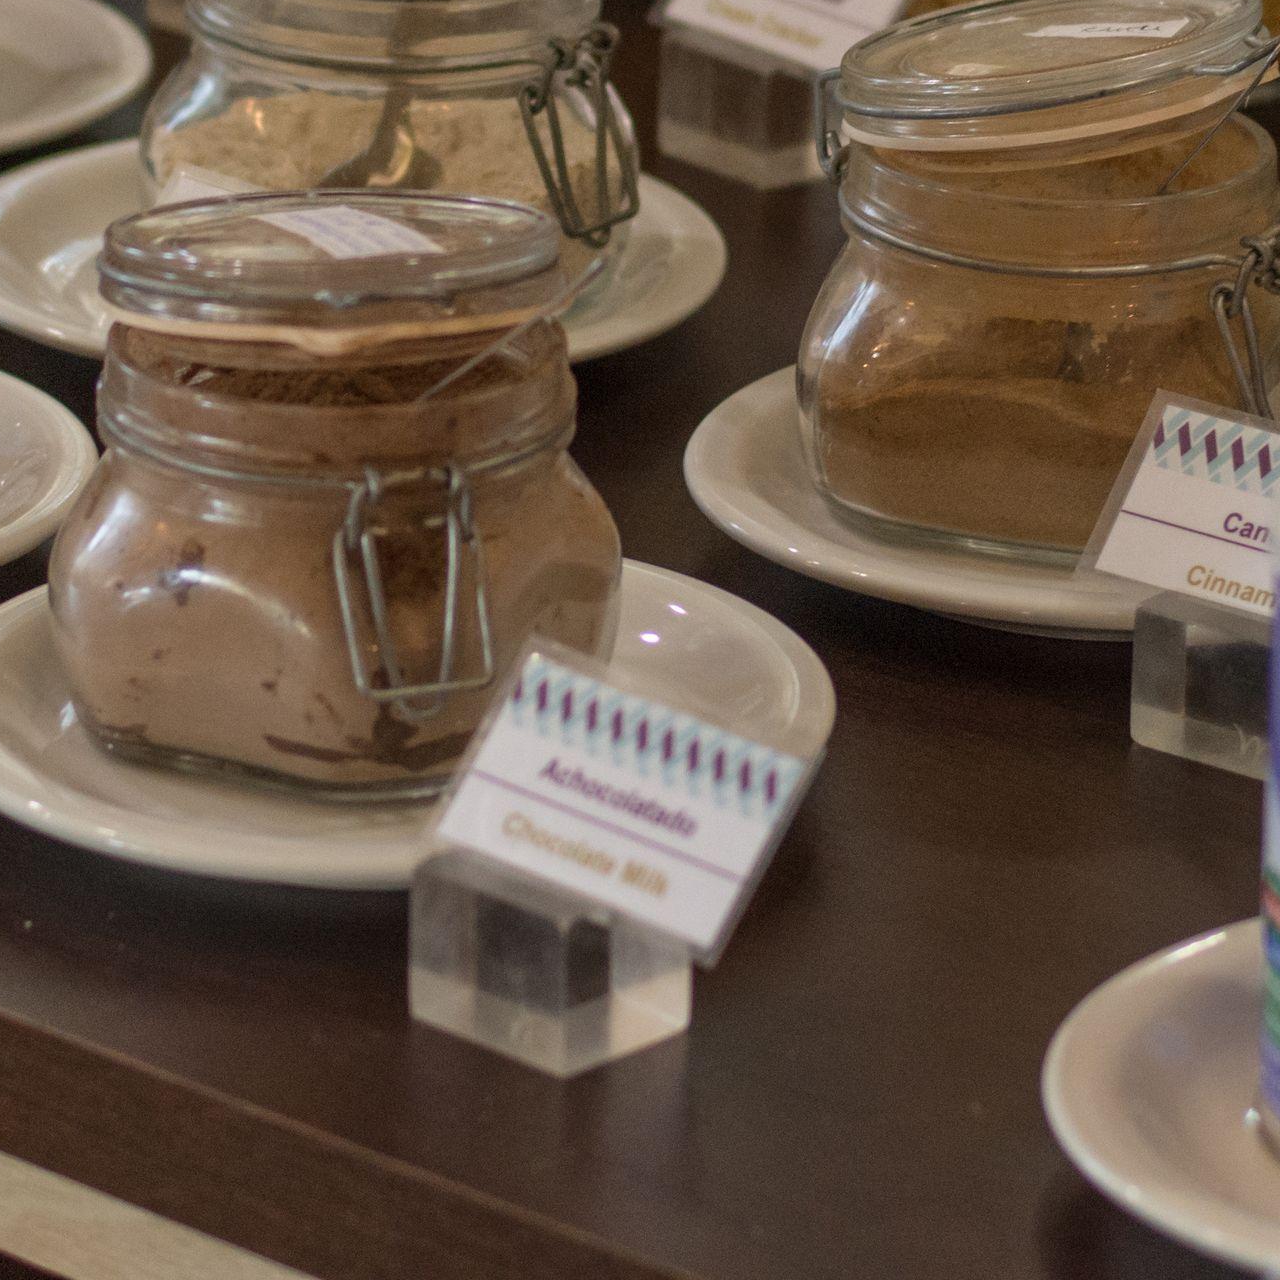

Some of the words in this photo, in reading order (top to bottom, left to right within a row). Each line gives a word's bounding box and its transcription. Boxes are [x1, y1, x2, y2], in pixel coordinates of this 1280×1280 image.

[1223, 512, 1270, 543] Can
[1186, 565, 1278, 608] Cinnam
[537, 756, 700, 838] Achocolatado
